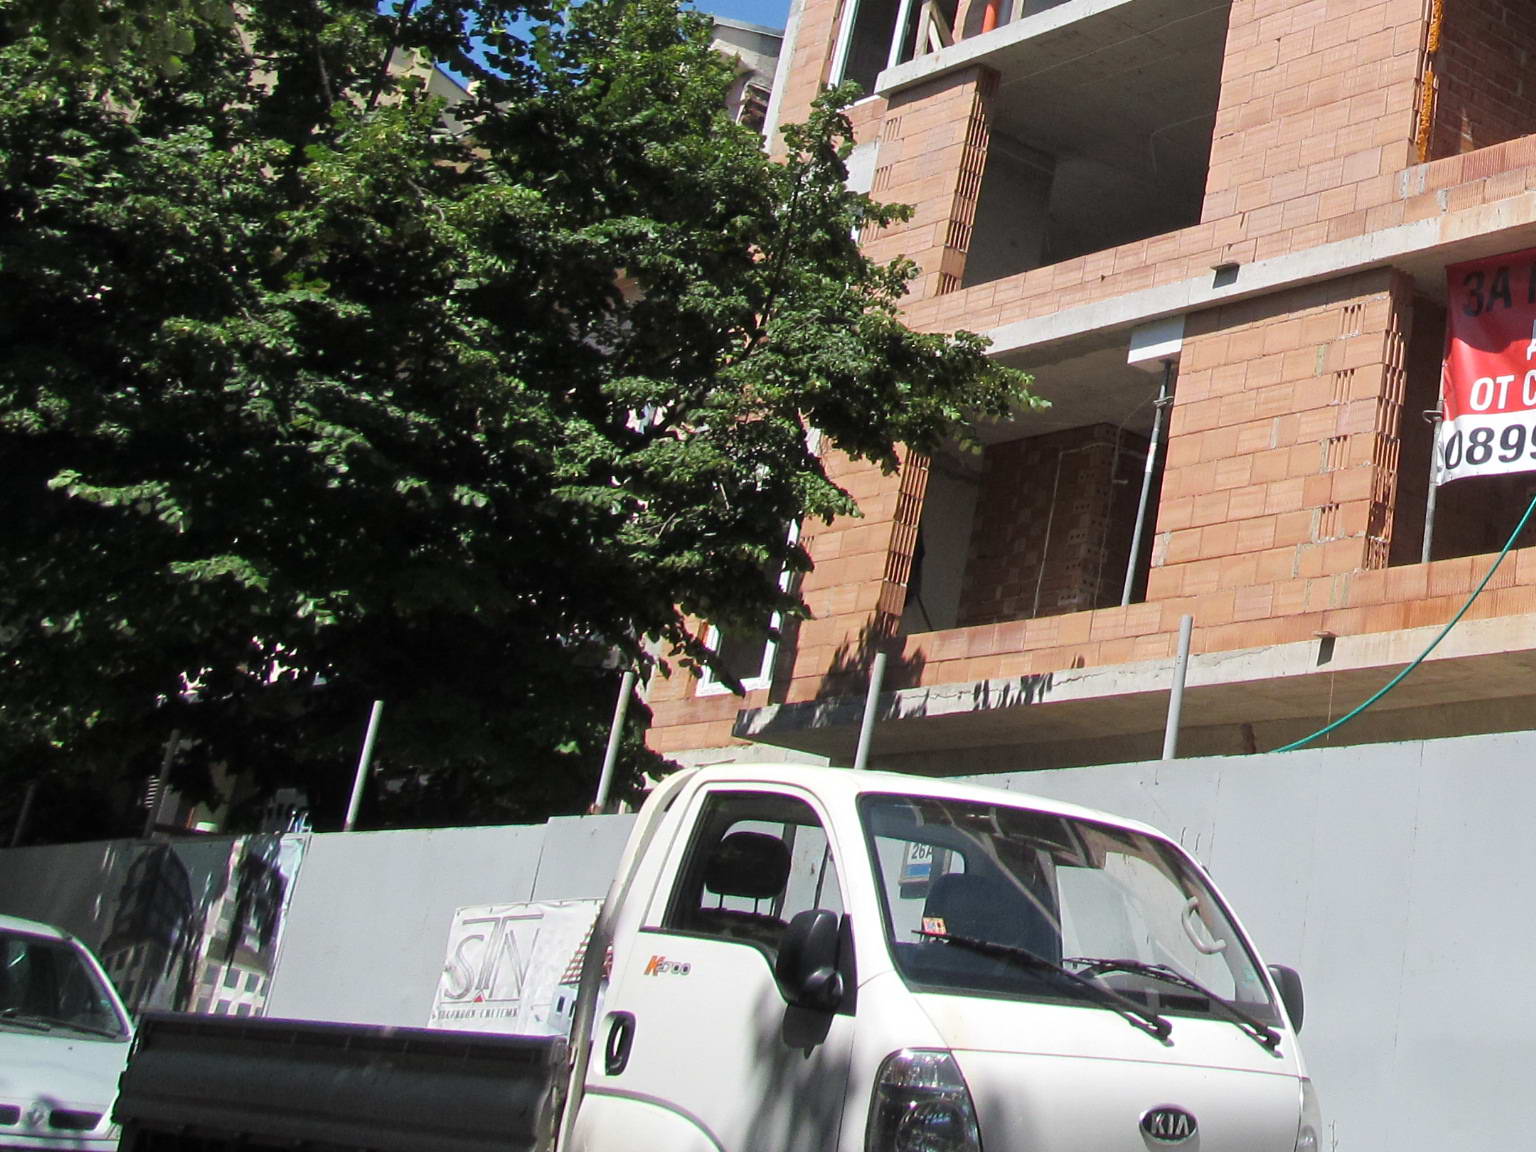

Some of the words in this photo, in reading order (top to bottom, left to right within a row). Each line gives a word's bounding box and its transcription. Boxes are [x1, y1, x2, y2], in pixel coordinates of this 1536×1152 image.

[1463, 266, 1512, 317] ЗА
[1470, 375, 1515, 411] ОТ
[1150, 1112, 1190, 1135] KIA
